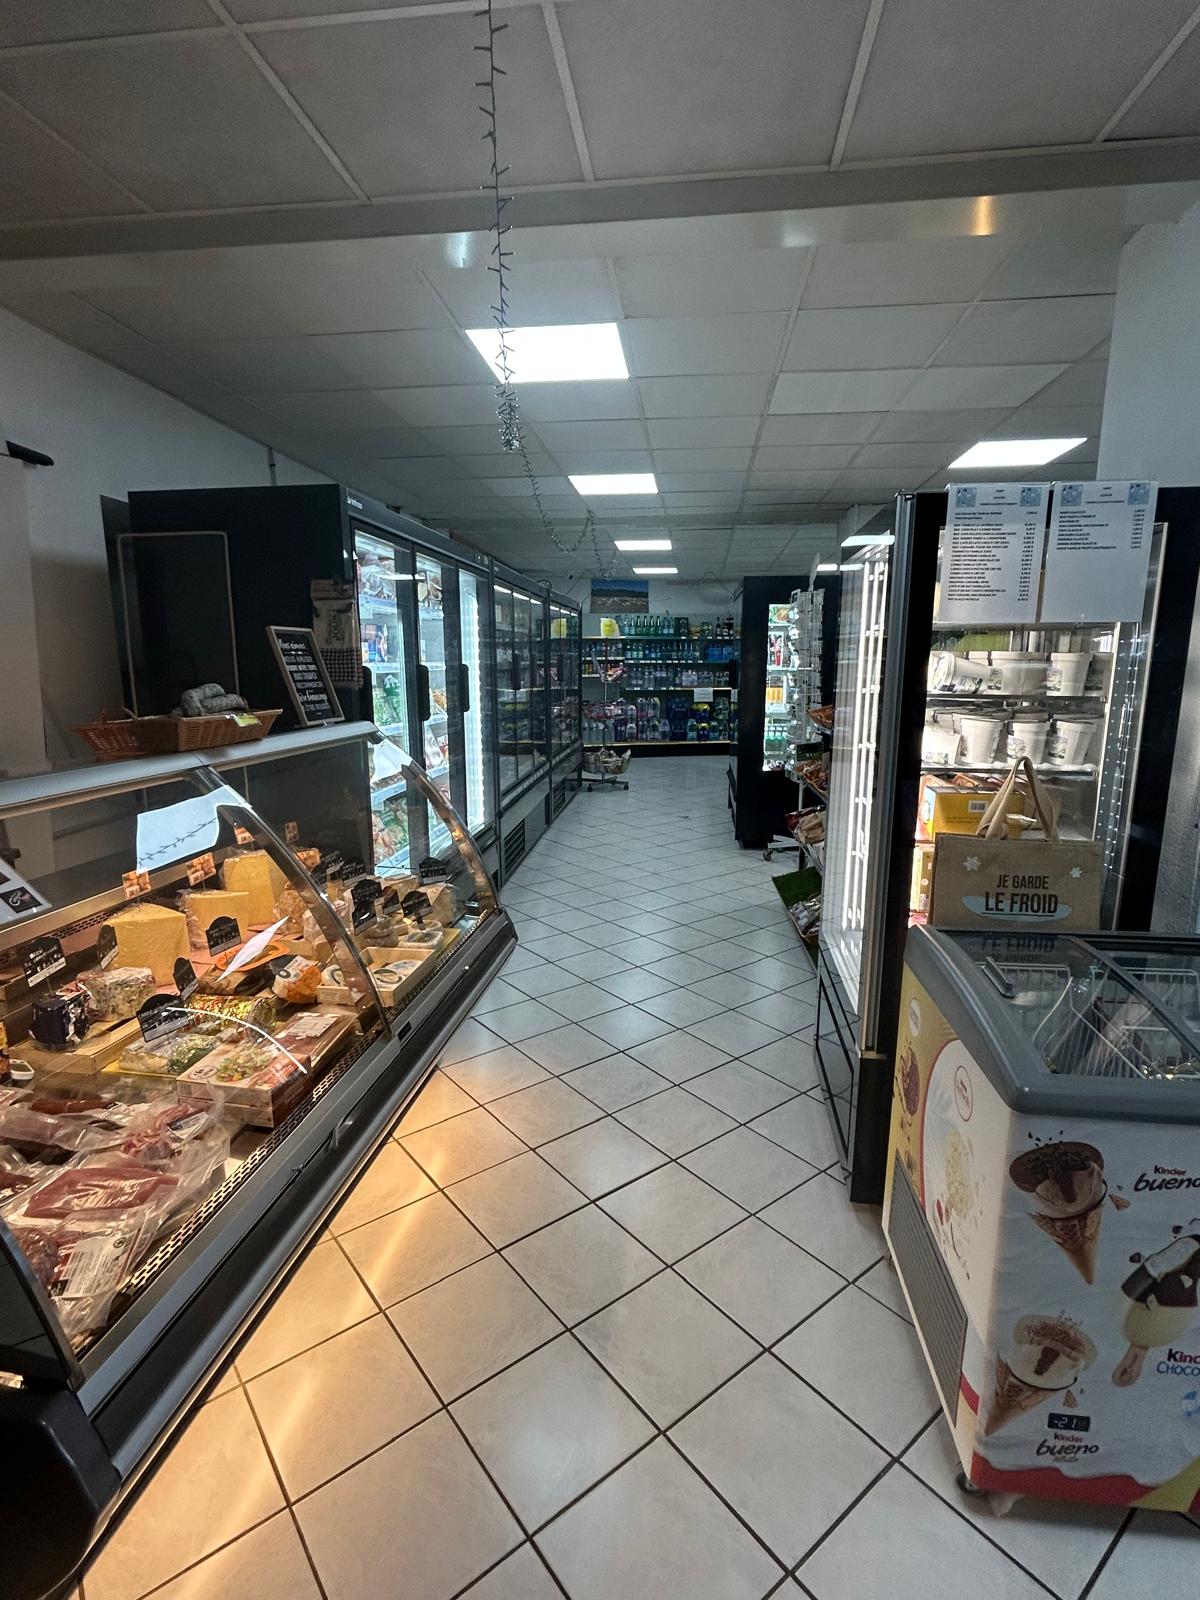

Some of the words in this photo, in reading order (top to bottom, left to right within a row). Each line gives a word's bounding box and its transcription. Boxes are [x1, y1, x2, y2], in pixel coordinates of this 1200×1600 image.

[996, 874, 1010, 888] JE
[1012, 874, 1050, 890] GARDE
[984, 891, 1004, 912] LE
[1009, 893, 1058, 914] FROID
[1036, 1438, 1100, 1456] bueno
